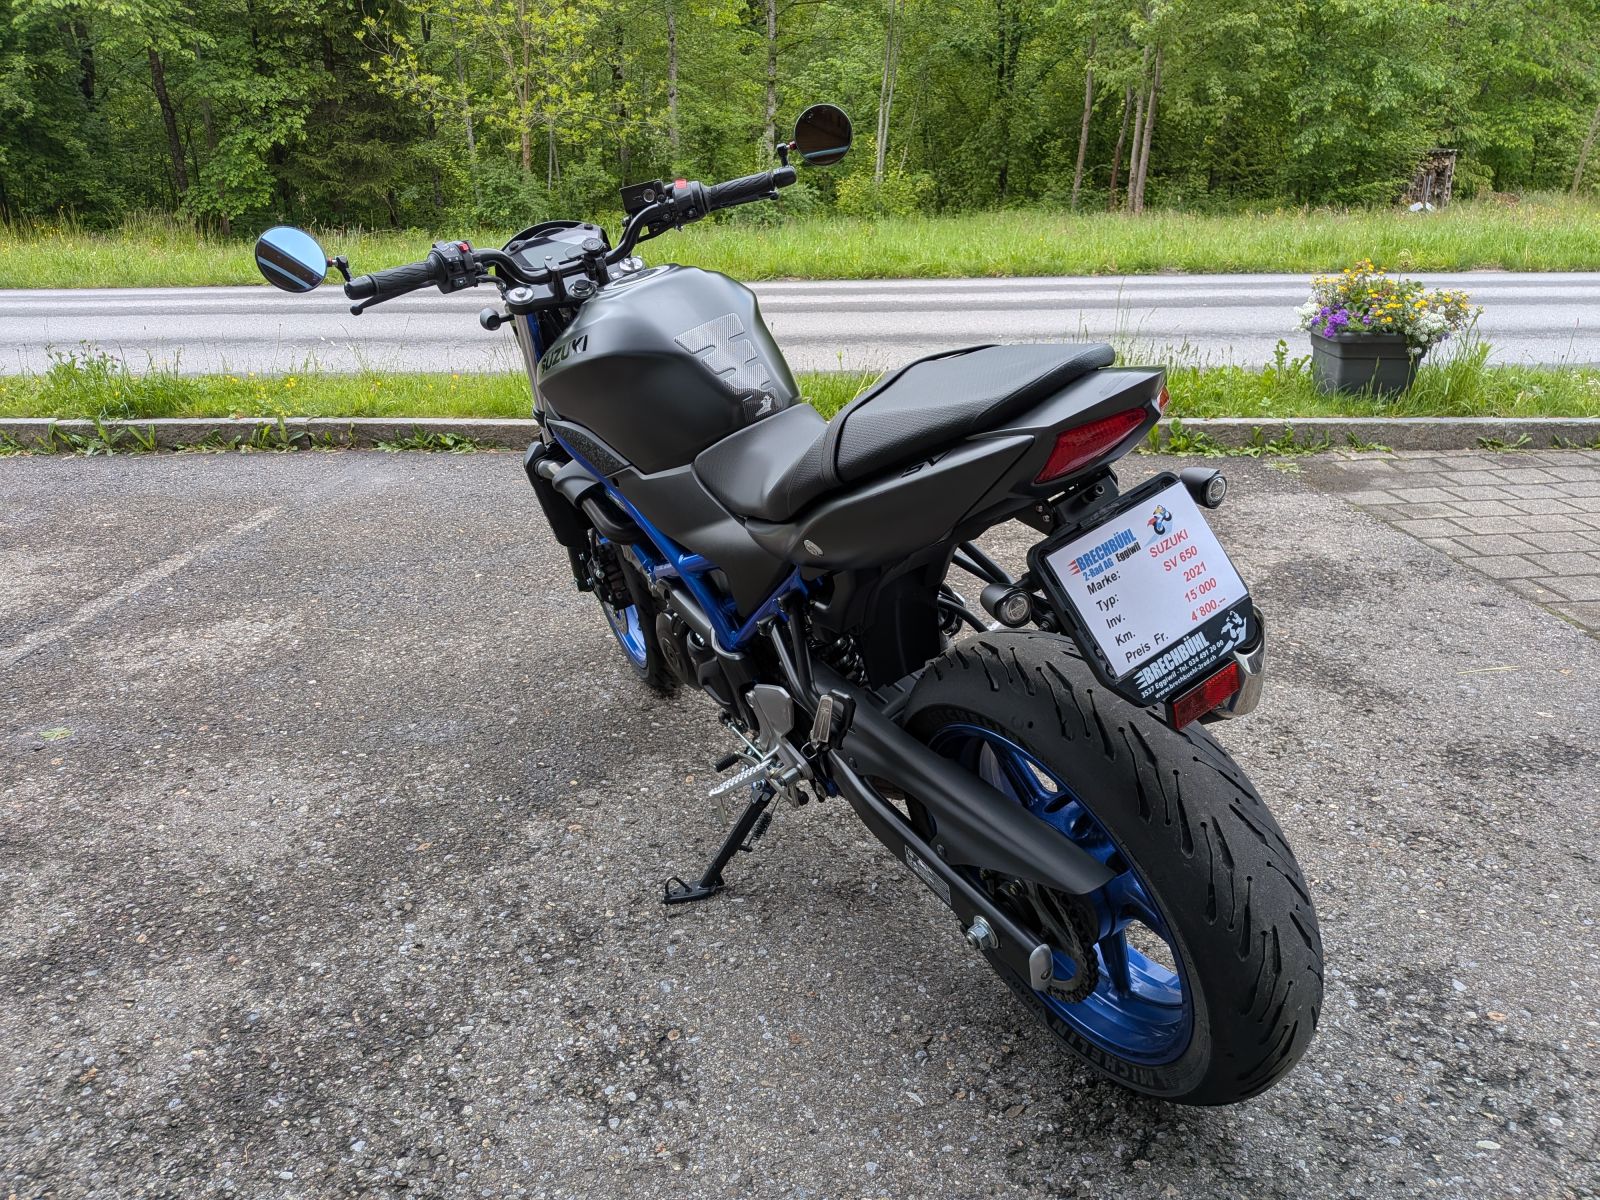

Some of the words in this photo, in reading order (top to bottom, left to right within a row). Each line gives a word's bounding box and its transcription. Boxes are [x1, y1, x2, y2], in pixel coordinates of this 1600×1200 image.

[541, 334, 588, 375] SUZUKI
[1075, 528, 1137, 572] BRECHBÜHL
[1083, 565, 1105, 582] 2-Rad
[1103, 557, 1115, 570] AG
[1115, 541, 1142, 563] Eggiwil
[1086, 570, 1121, 596] Marke:
[1149, 528, 1189, 558] SUZUKI
[1095, 593, 1120, 612] Typ:
[1163, 556, 1179, 572] SV
[1179, 545, 1198, 562] 650
[1105, 613, 1126, 629] Inv.
[1183, 561, 1208, 583] 2021
[1114, 631, 1136, 647] Km.
[1125, 641, 1151, 663] Preis
[1153, 631, 1169, 646] Fr.
[1143, 631, 1210, 685] BRECHBÜHL
[1141, 685, 1155, 699] 3537
[1155, 671, 1177, 690] Eggiwil
[1178, 662, 1190, 674] Tel.
[1051, 1017, 1156, 1086] MICHELIN
